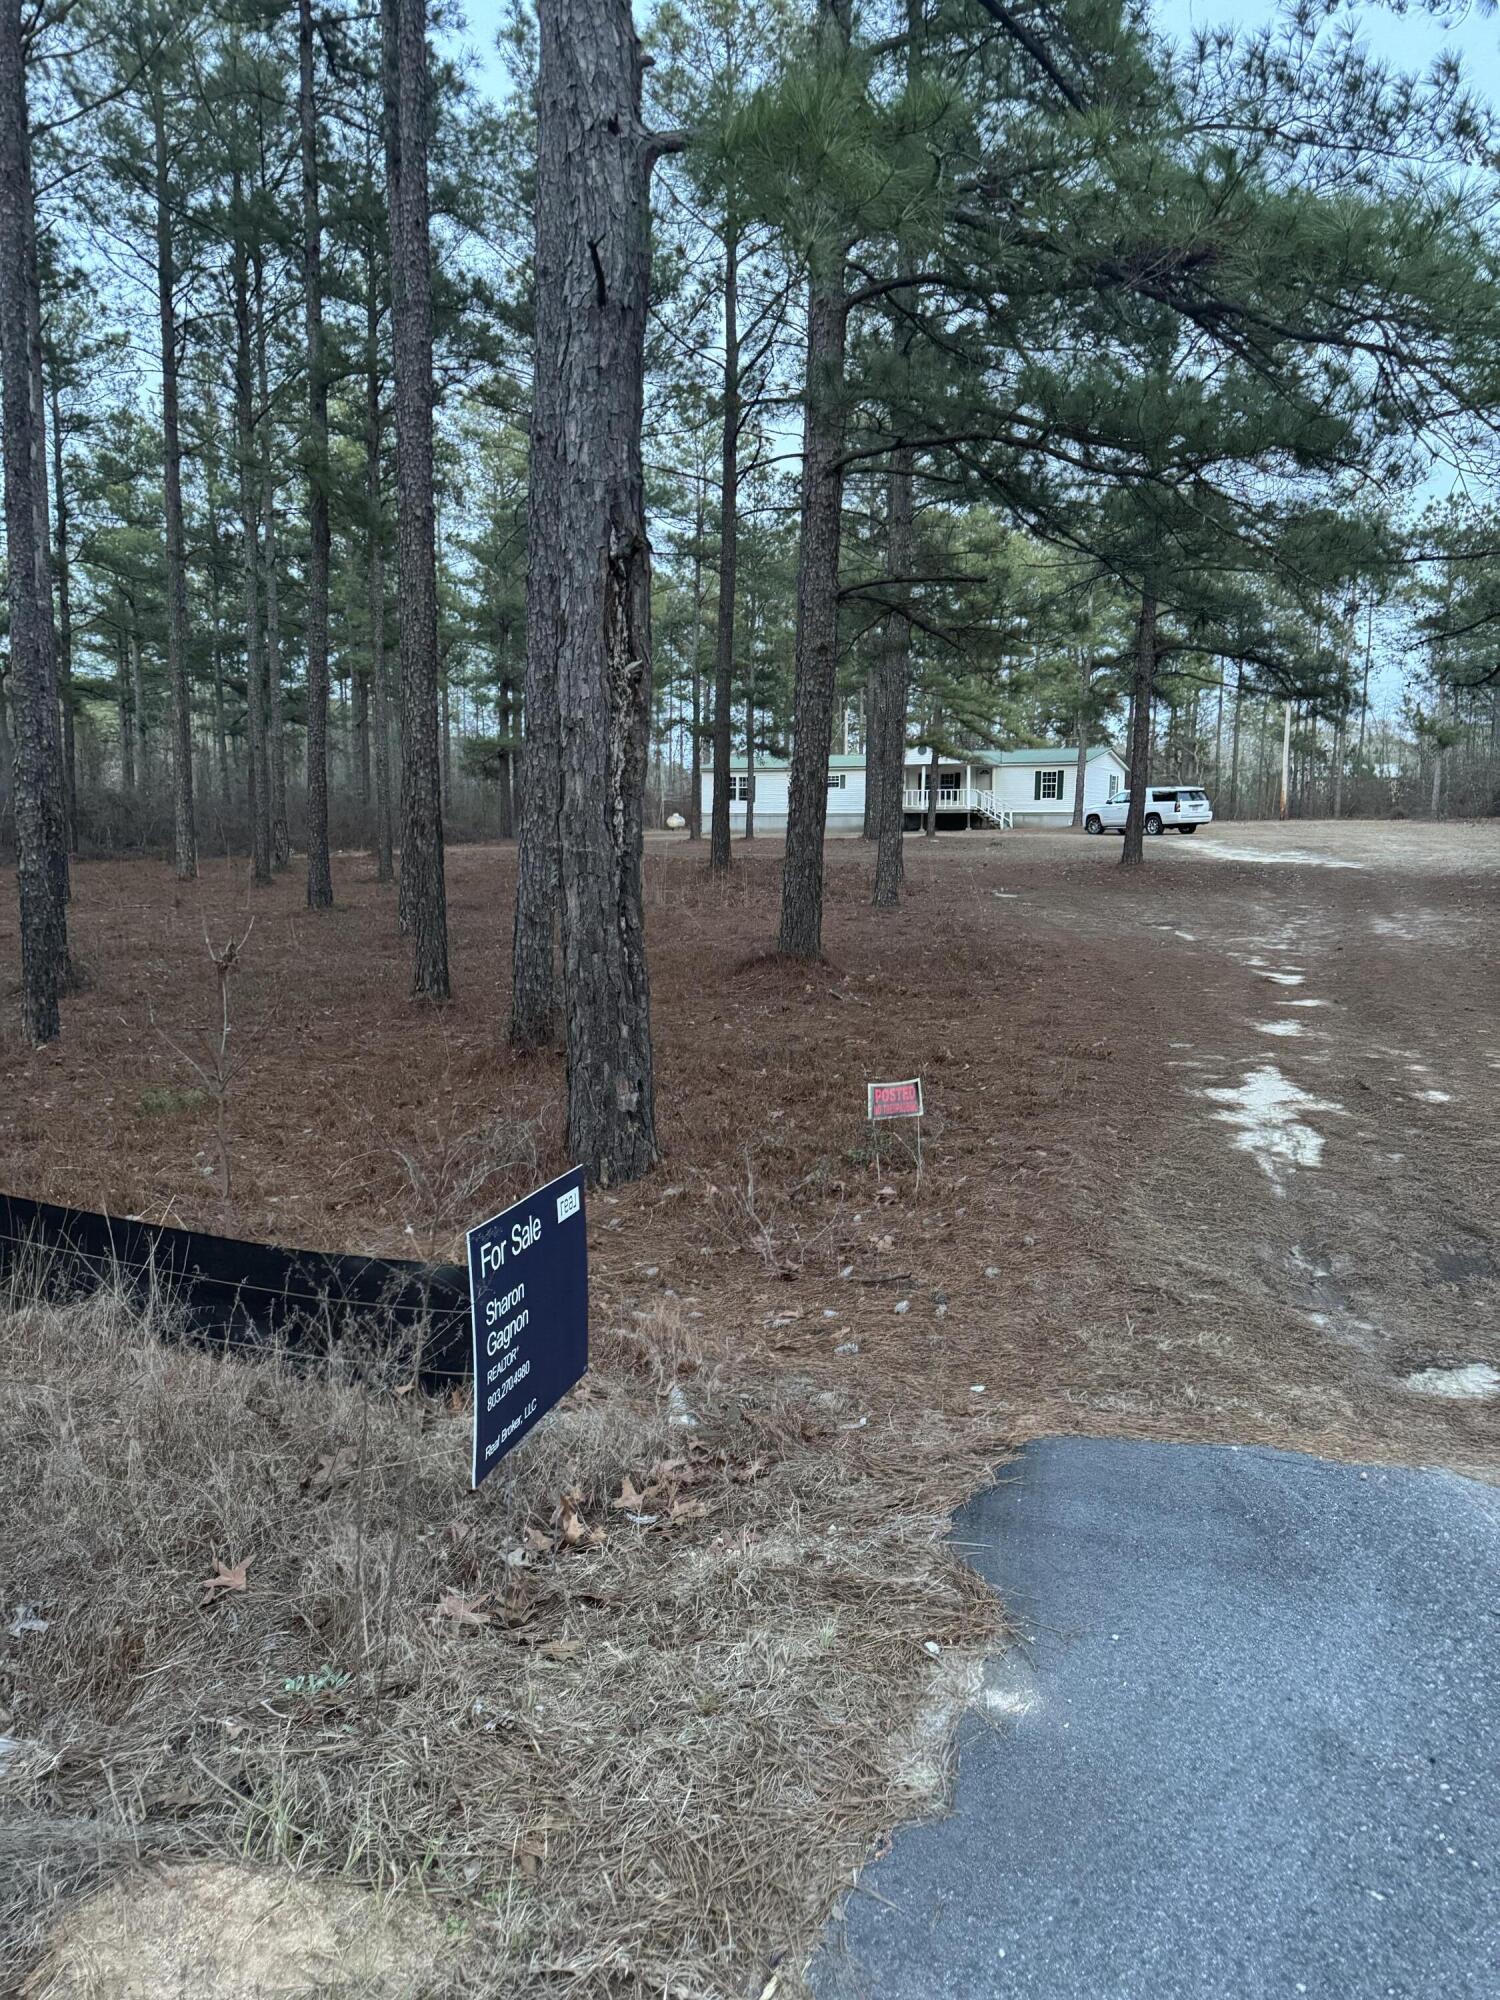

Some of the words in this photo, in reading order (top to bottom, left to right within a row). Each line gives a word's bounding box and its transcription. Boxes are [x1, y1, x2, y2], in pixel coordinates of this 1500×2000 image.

[874, 1085, 916, 1103] POSTED
[560, 1193, 577, 1216] real
[481, 1240, 507, 1278] For
[511, 1215, 541, 1256] Sale
[486, 1283, 524, 1325] Sharon
[487, 1309, 529, 1356] Gagnon
[485, 1434, 500, 1461] Real
[501, 1415, 523, 1443] Broker,
[524, 1398, 537, 1419] LLC
